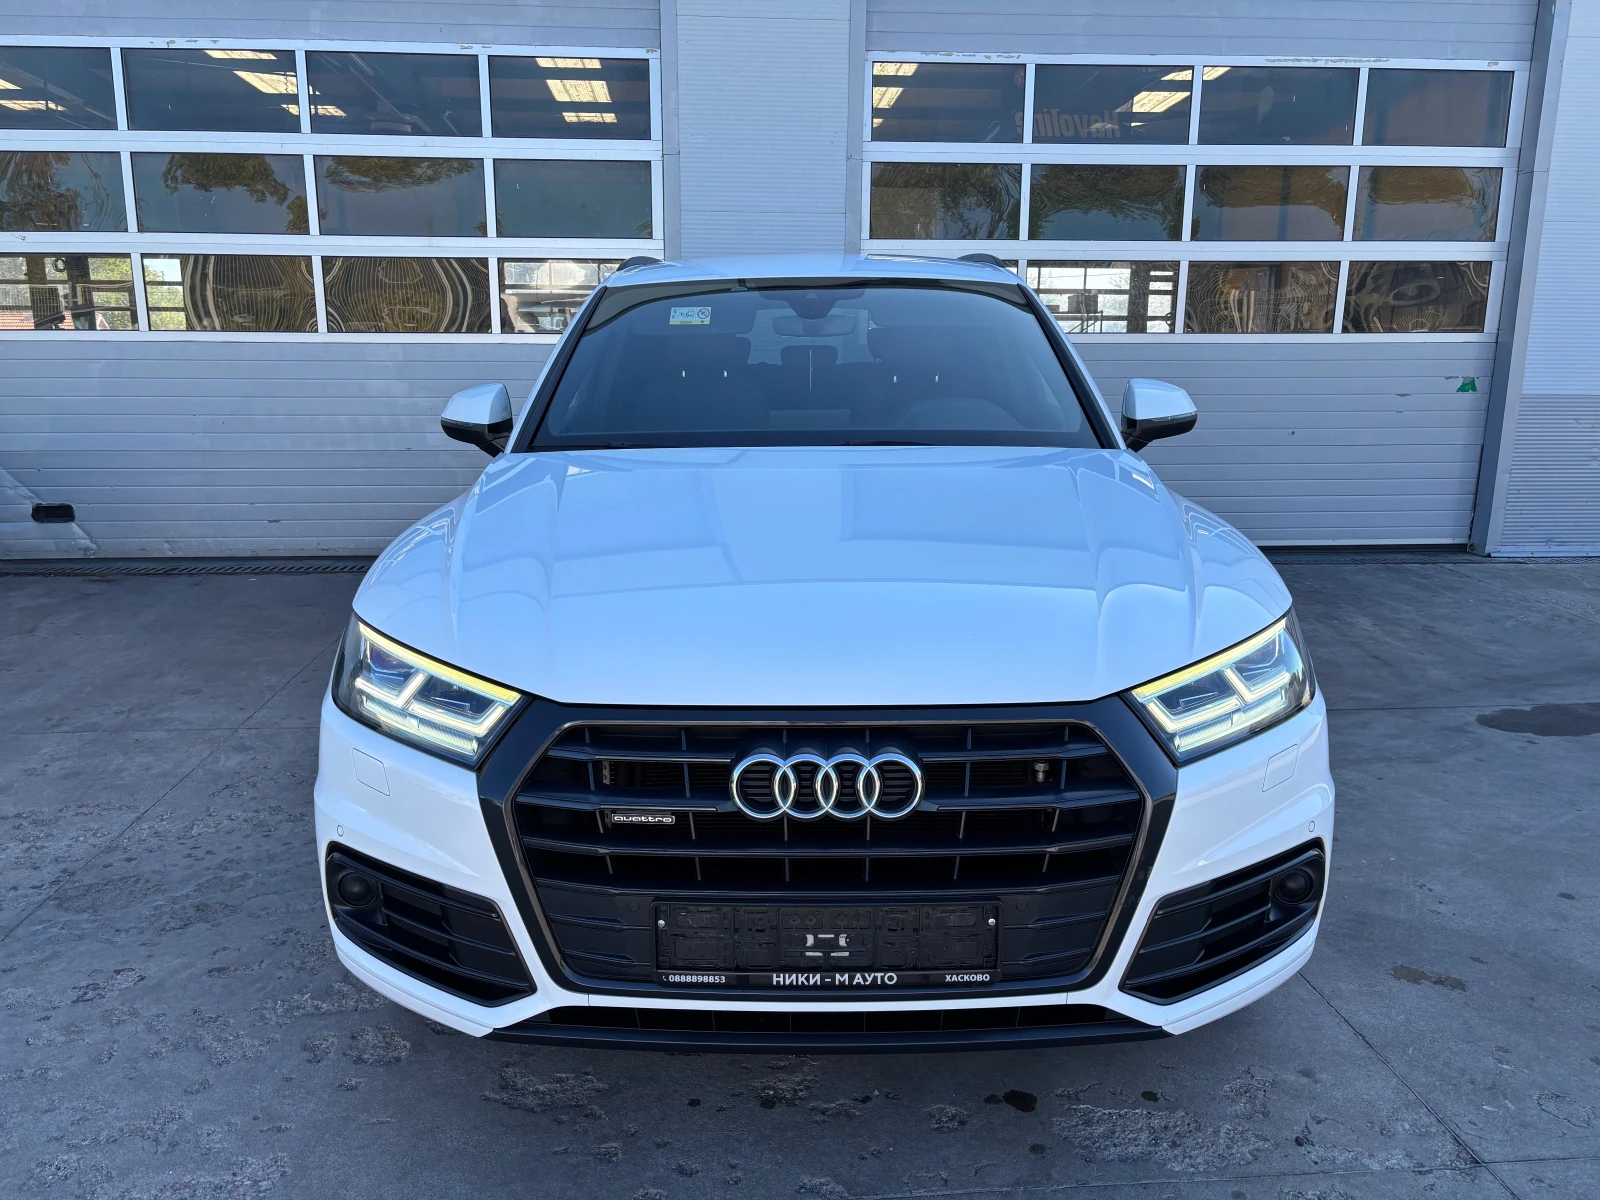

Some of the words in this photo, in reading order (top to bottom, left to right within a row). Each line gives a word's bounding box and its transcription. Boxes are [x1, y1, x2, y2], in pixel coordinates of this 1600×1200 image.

[668, 975, 726, 983] 0888898853
[772, 973, 821, 985] НИКИ
[835, 973, 849, 985] М
[853, 972, 897, 984] АУТО
[945, 973, 990, 982] ХАСКОВО
